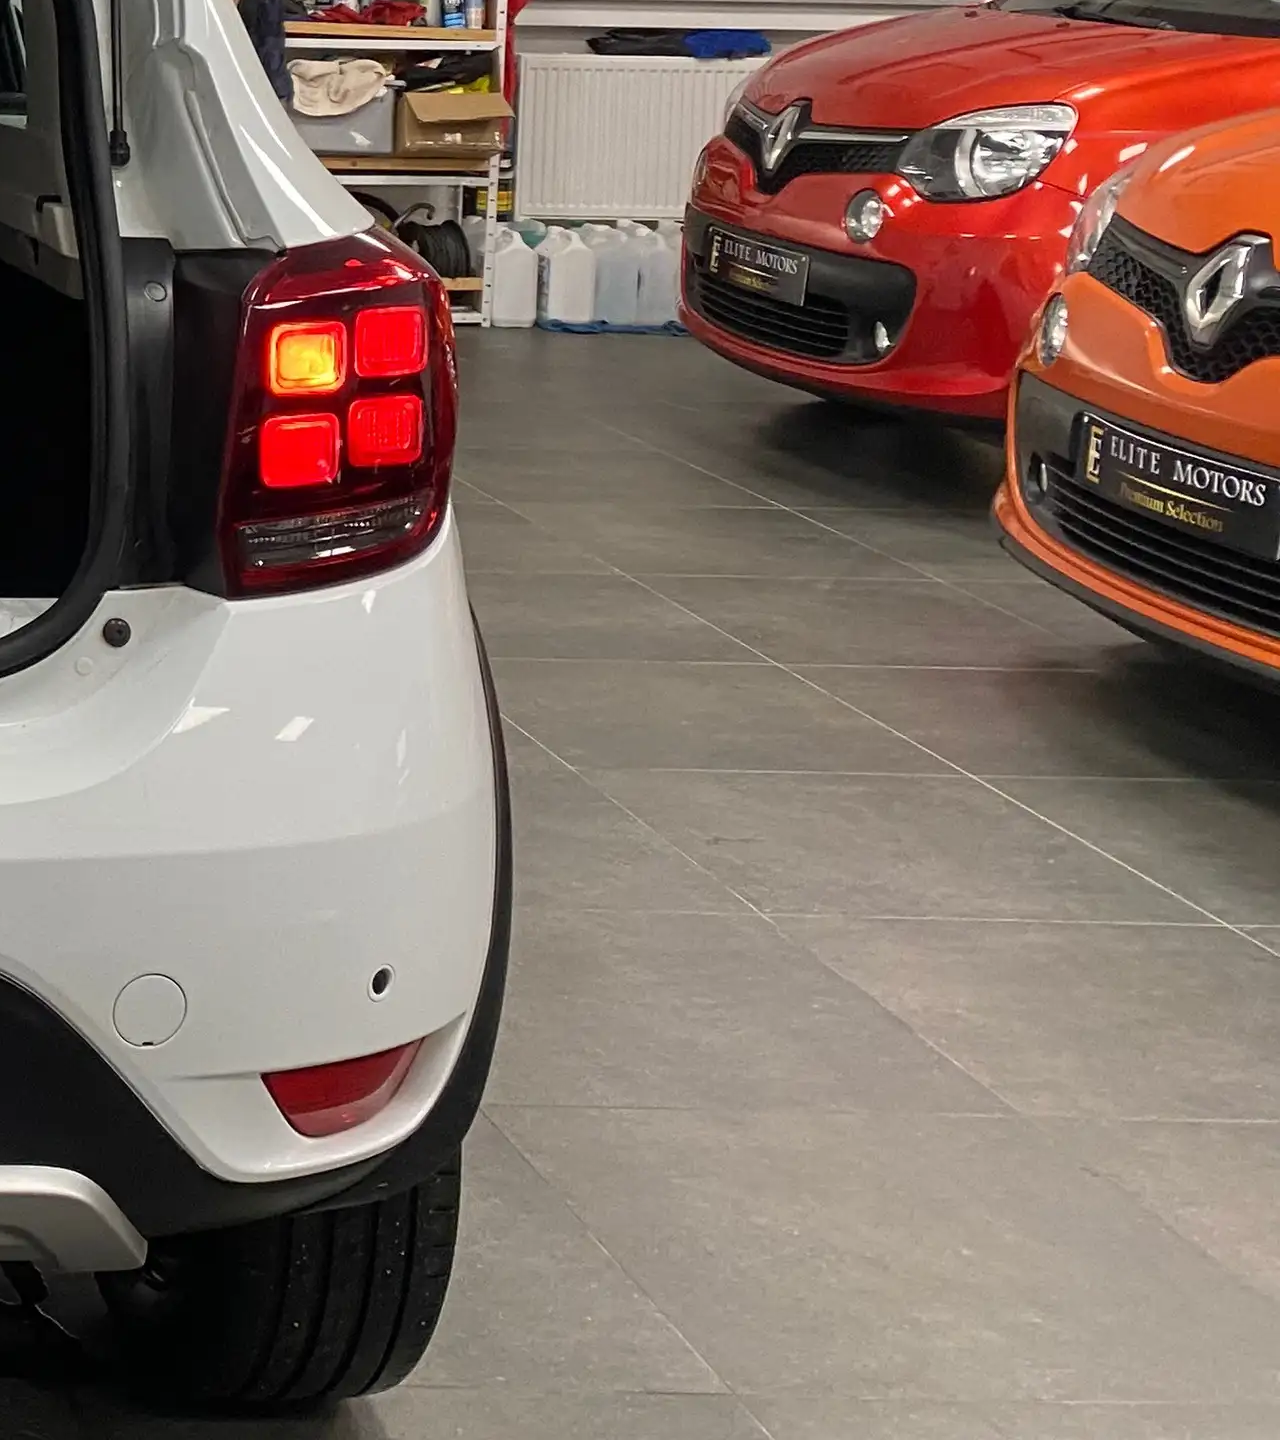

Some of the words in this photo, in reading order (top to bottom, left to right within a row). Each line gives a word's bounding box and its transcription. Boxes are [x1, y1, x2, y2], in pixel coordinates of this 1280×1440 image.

[724, 239, 752, 261] ELITE
[755, 249, 798, 275] MOTORS
[1109, 435, 1161, 475] ELITE
[1172, 460, 1267, 507] MOTORS
[1117, 481, 1164, 515] Premium
[1165, 500, 1224, 533] Selection
